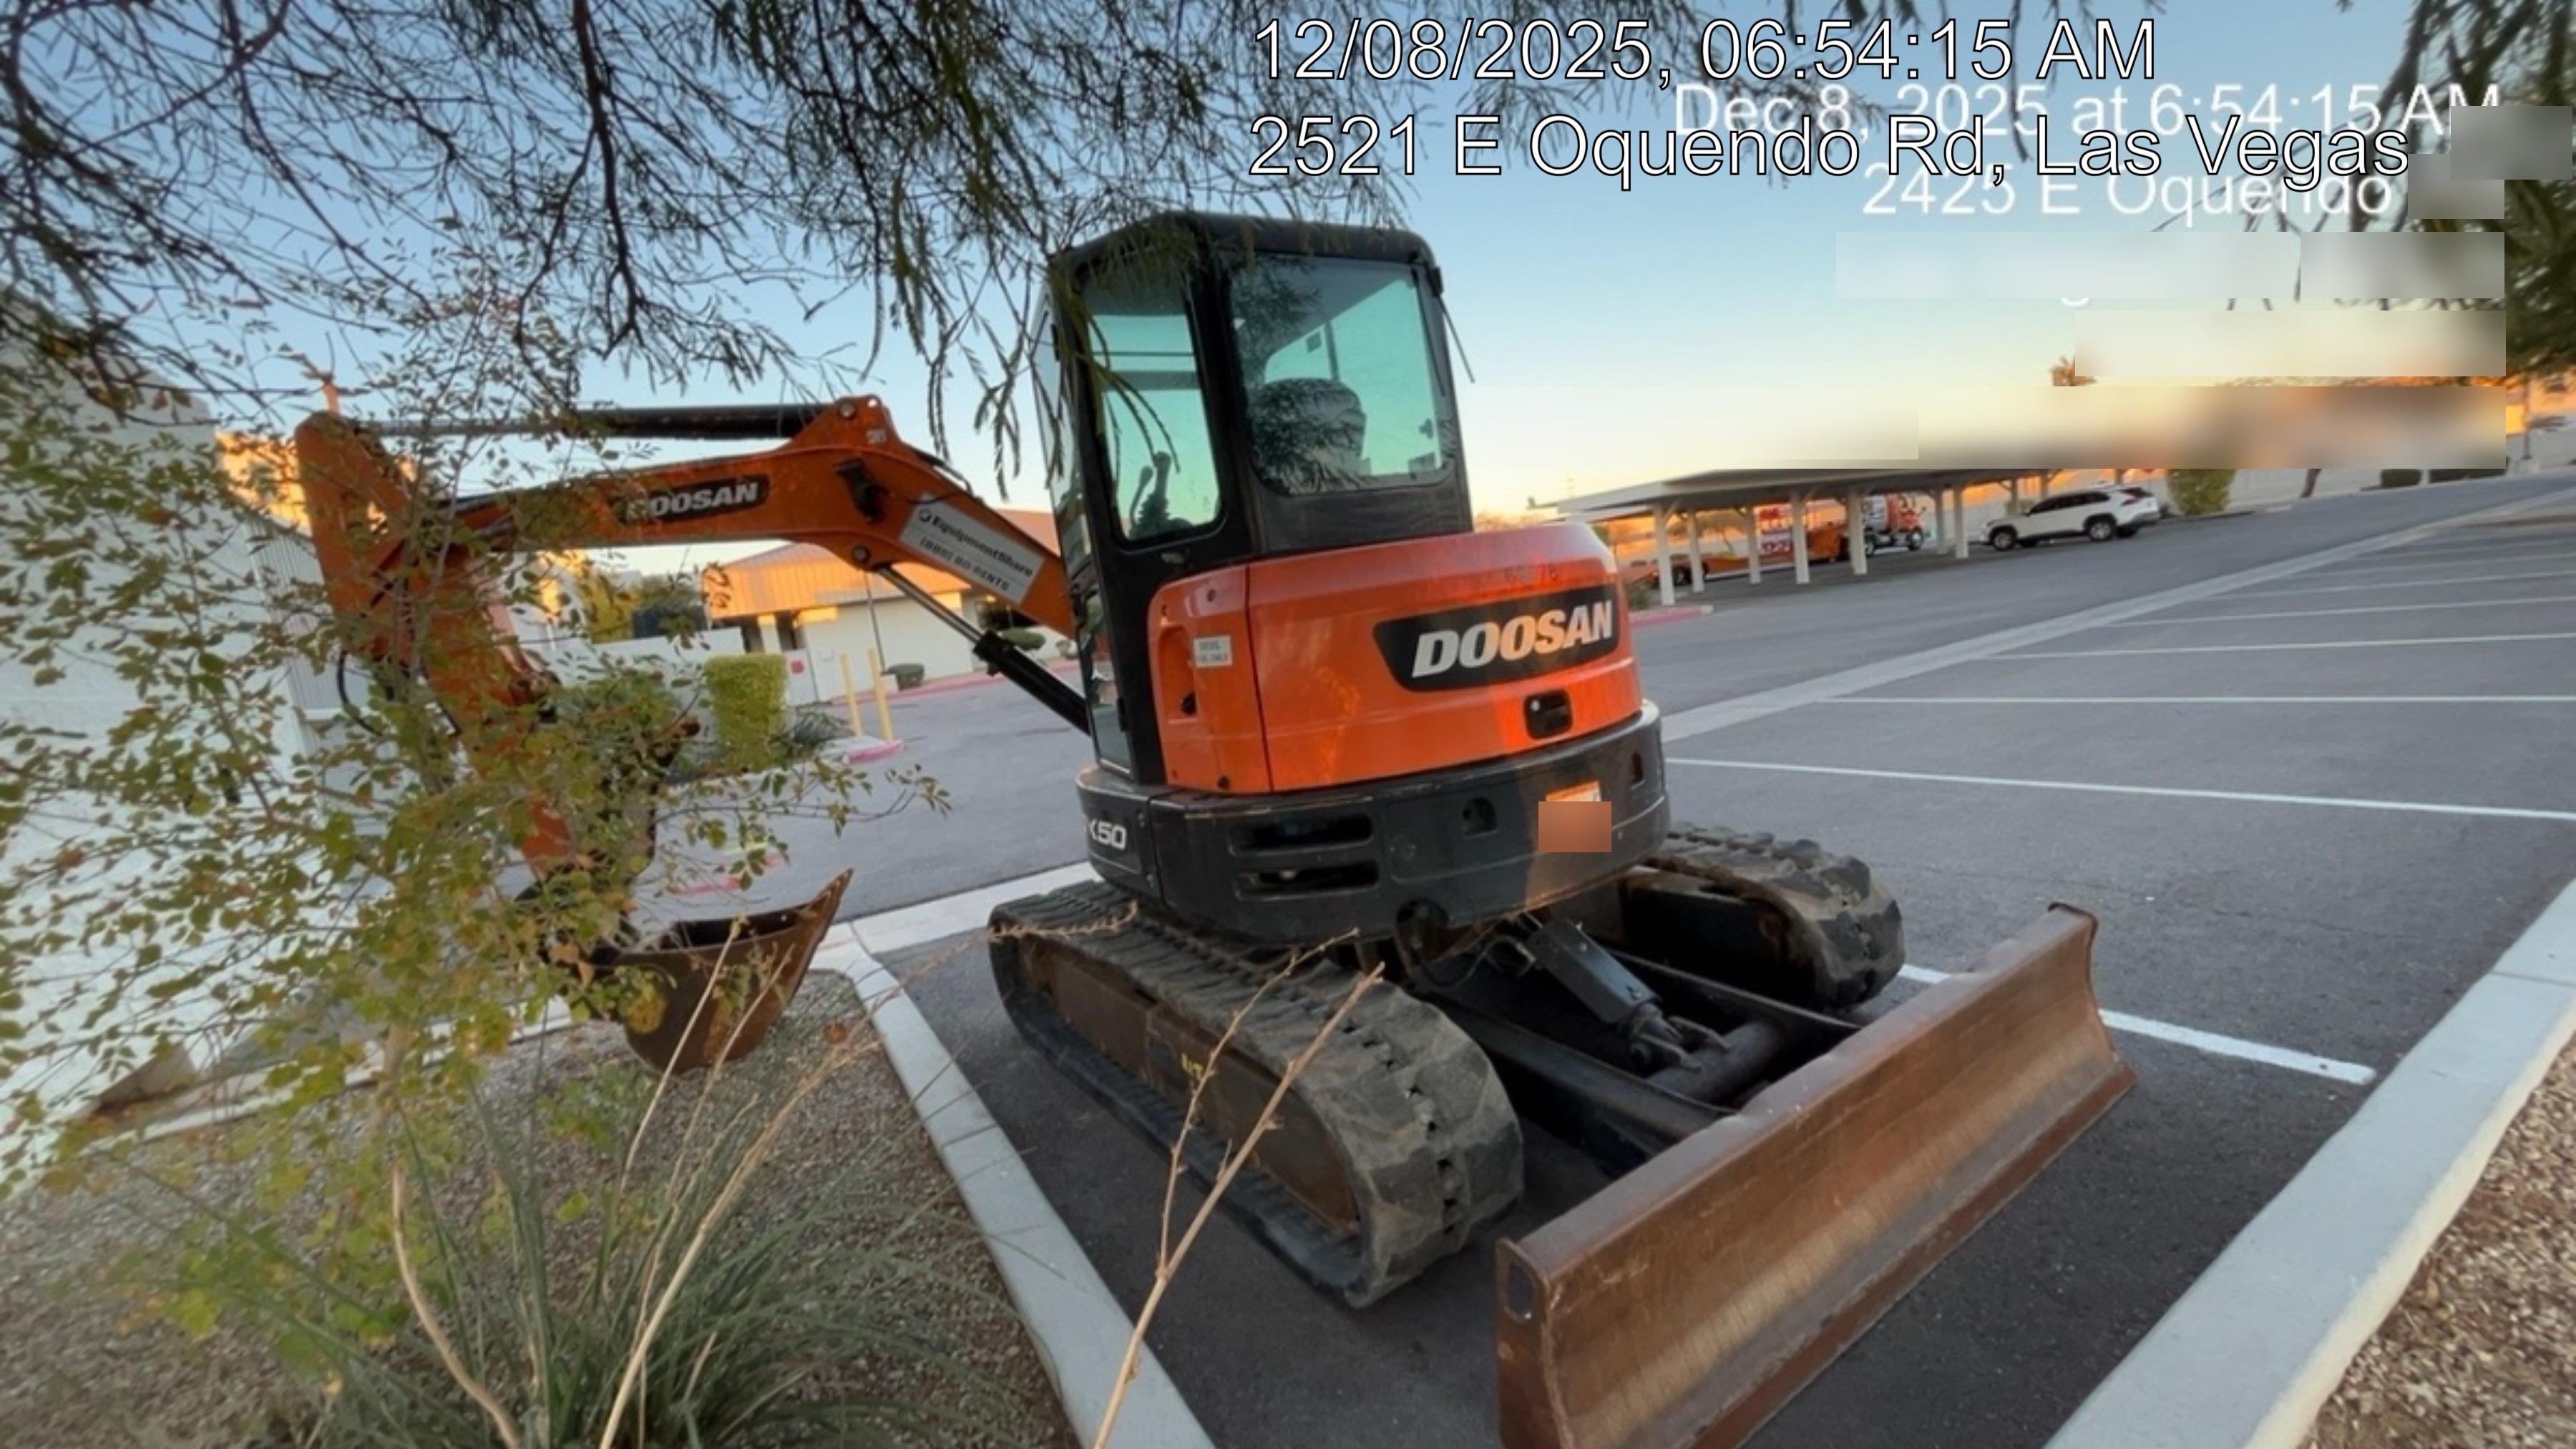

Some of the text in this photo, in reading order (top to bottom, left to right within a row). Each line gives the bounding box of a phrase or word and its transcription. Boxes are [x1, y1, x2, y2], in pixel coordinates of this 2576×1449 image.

[630, 482, 759, 522] OOSAN
[932, 514, 1033, 577] EquipmentShare
[1412, 600, 1613, 678] DOOSAN
